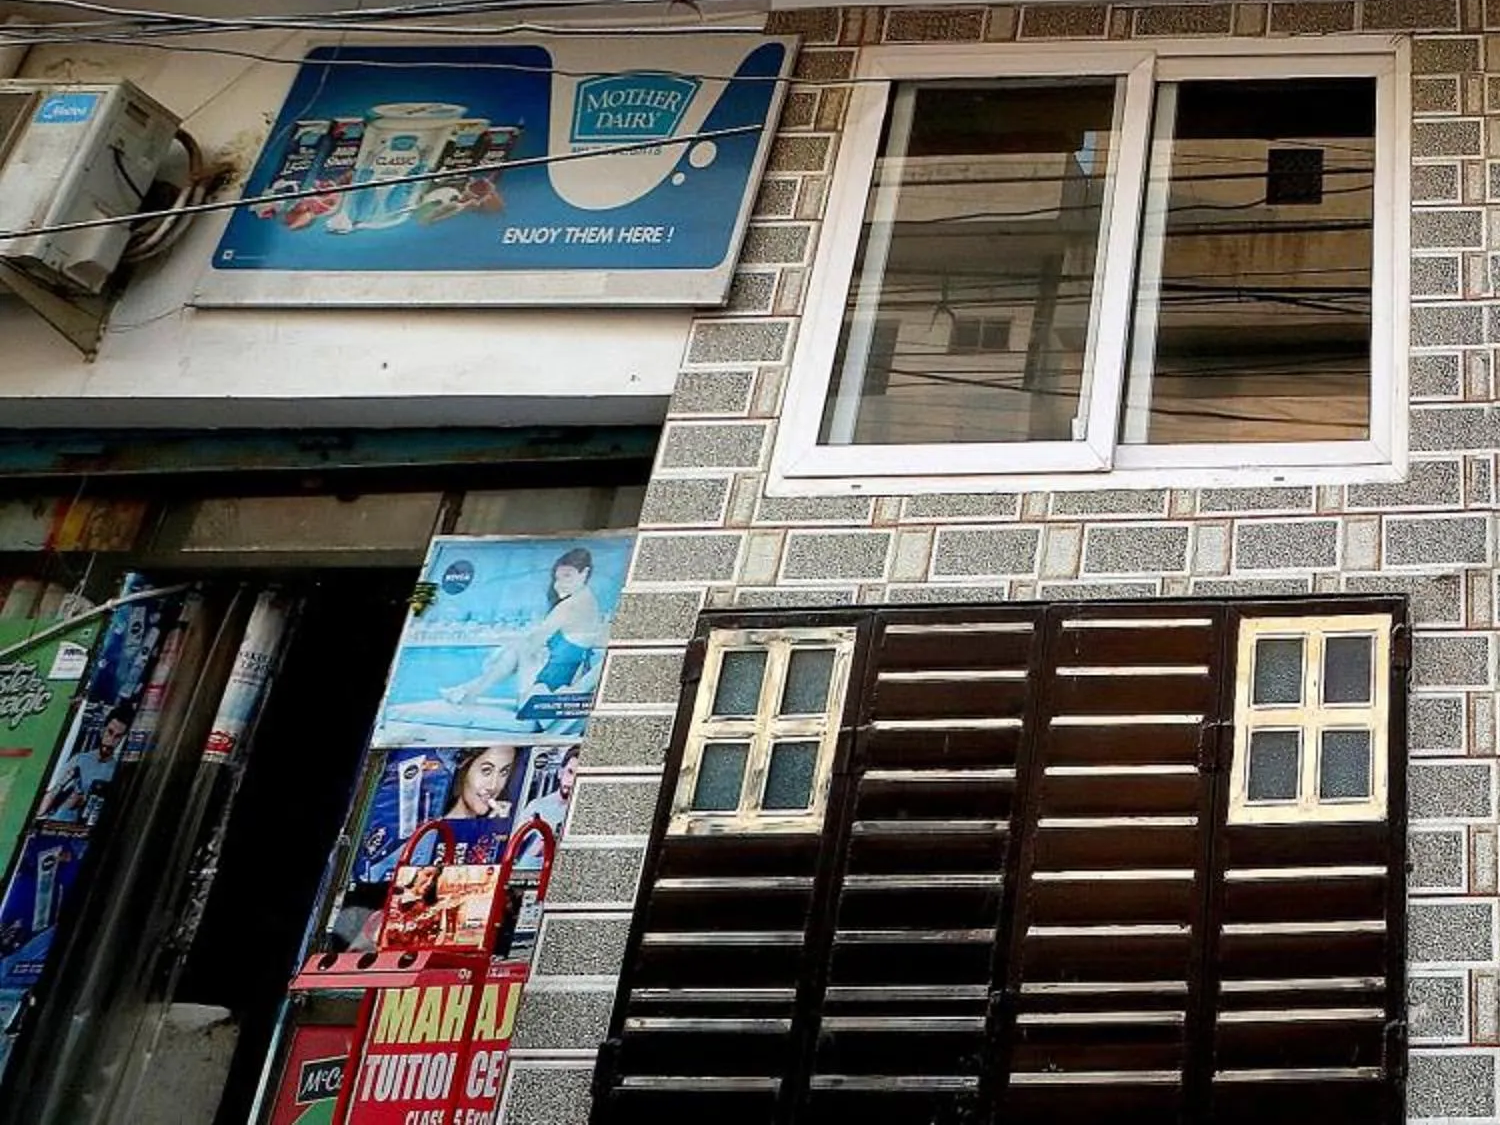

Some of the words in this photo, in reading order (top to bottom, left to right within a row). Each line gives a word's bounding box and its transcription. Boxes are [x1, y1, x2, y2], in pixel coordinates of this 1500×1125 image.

[587, 88, 682, 115] MOTHER
[596, 111, 658, 129] DAIRY
[503, 227, 561, 244] ENJOY
[564, 227, 613, 244] THEM
[617, 227, 663, 244] HERE
[466, 1049, 504, 1099] CE
